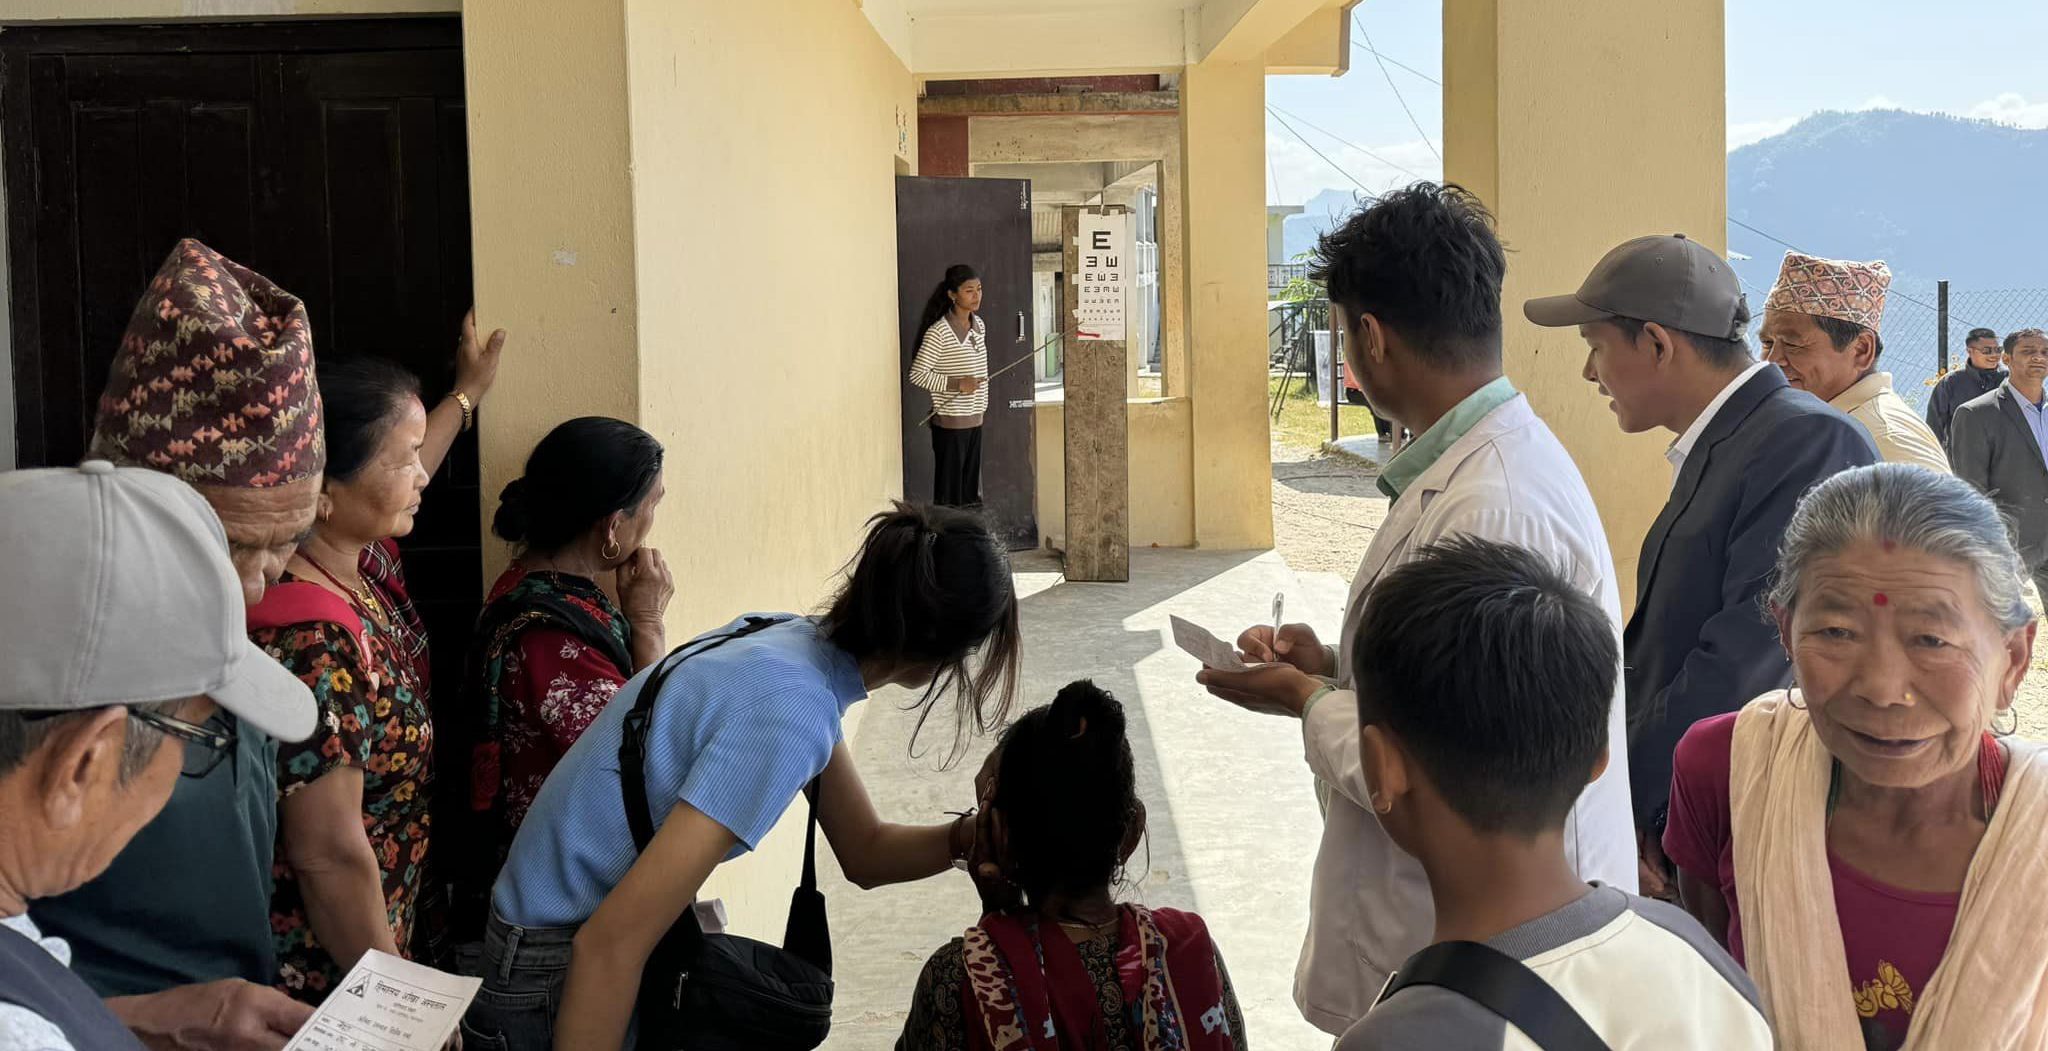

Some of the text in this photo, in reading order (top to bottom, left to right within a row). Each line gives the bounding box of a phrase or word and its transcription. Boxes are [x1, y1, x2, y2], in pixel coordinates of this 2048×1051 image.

[1093, 231, 1111, 250] E
[375, 980, 401, 997] हिमालय
[422, 998, 448, 1010] अस्पताल
